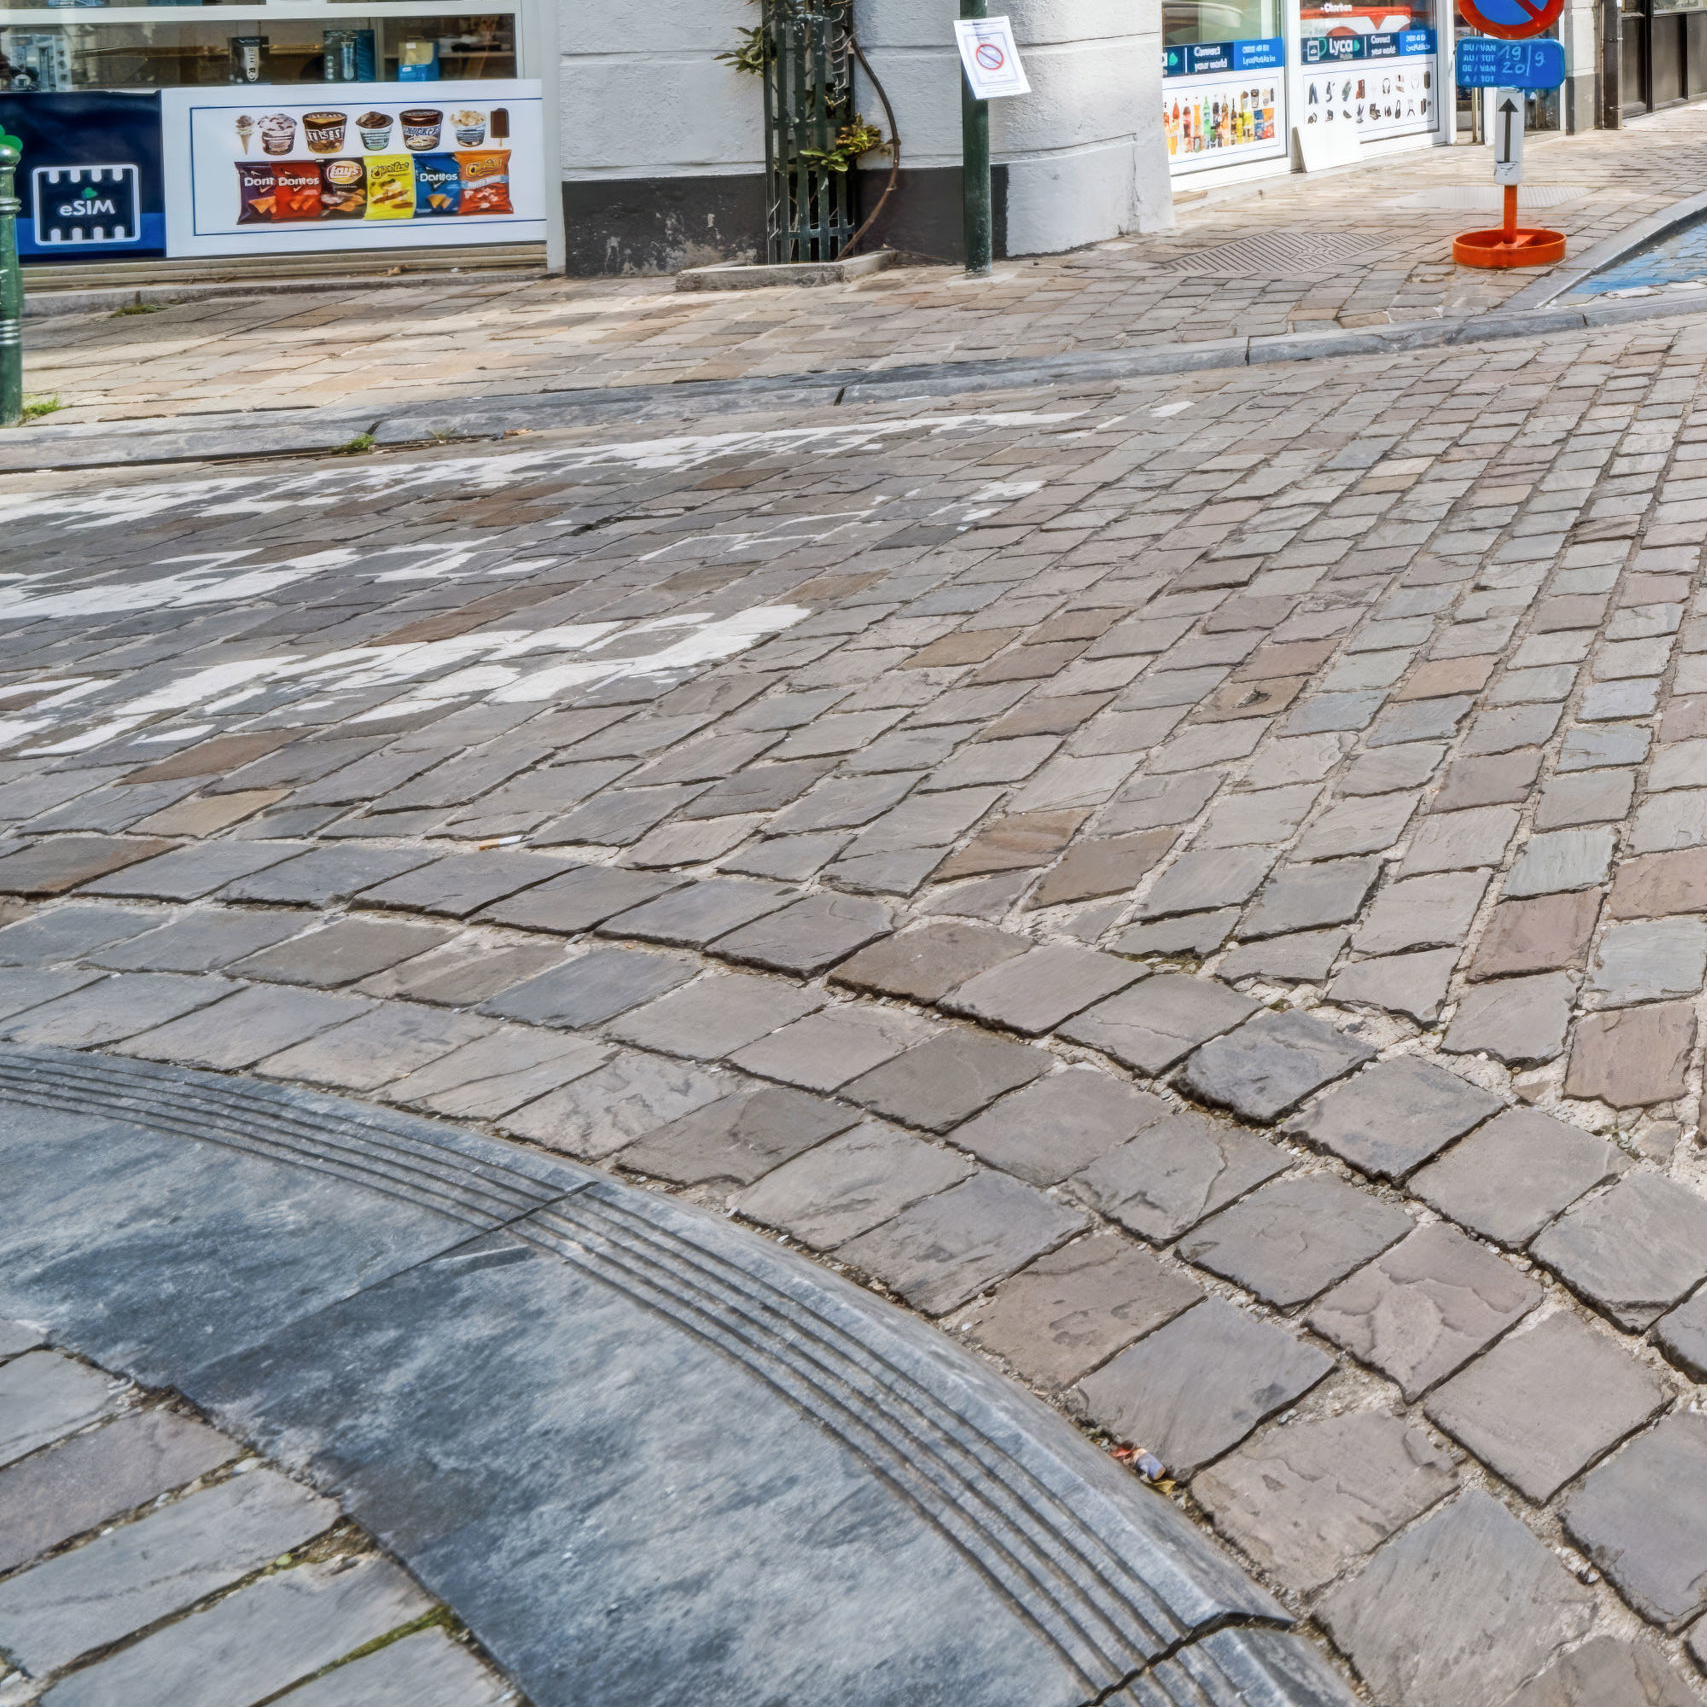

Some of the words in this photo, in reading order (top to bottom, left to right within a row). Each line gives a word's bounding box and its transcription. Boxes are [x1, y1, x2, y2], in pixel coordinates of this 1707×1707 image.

[1328, 38, 1354, 56] Lyca
[1502, 61, 1526, 74] 20
[59, 199, 116, 216] eSIM
